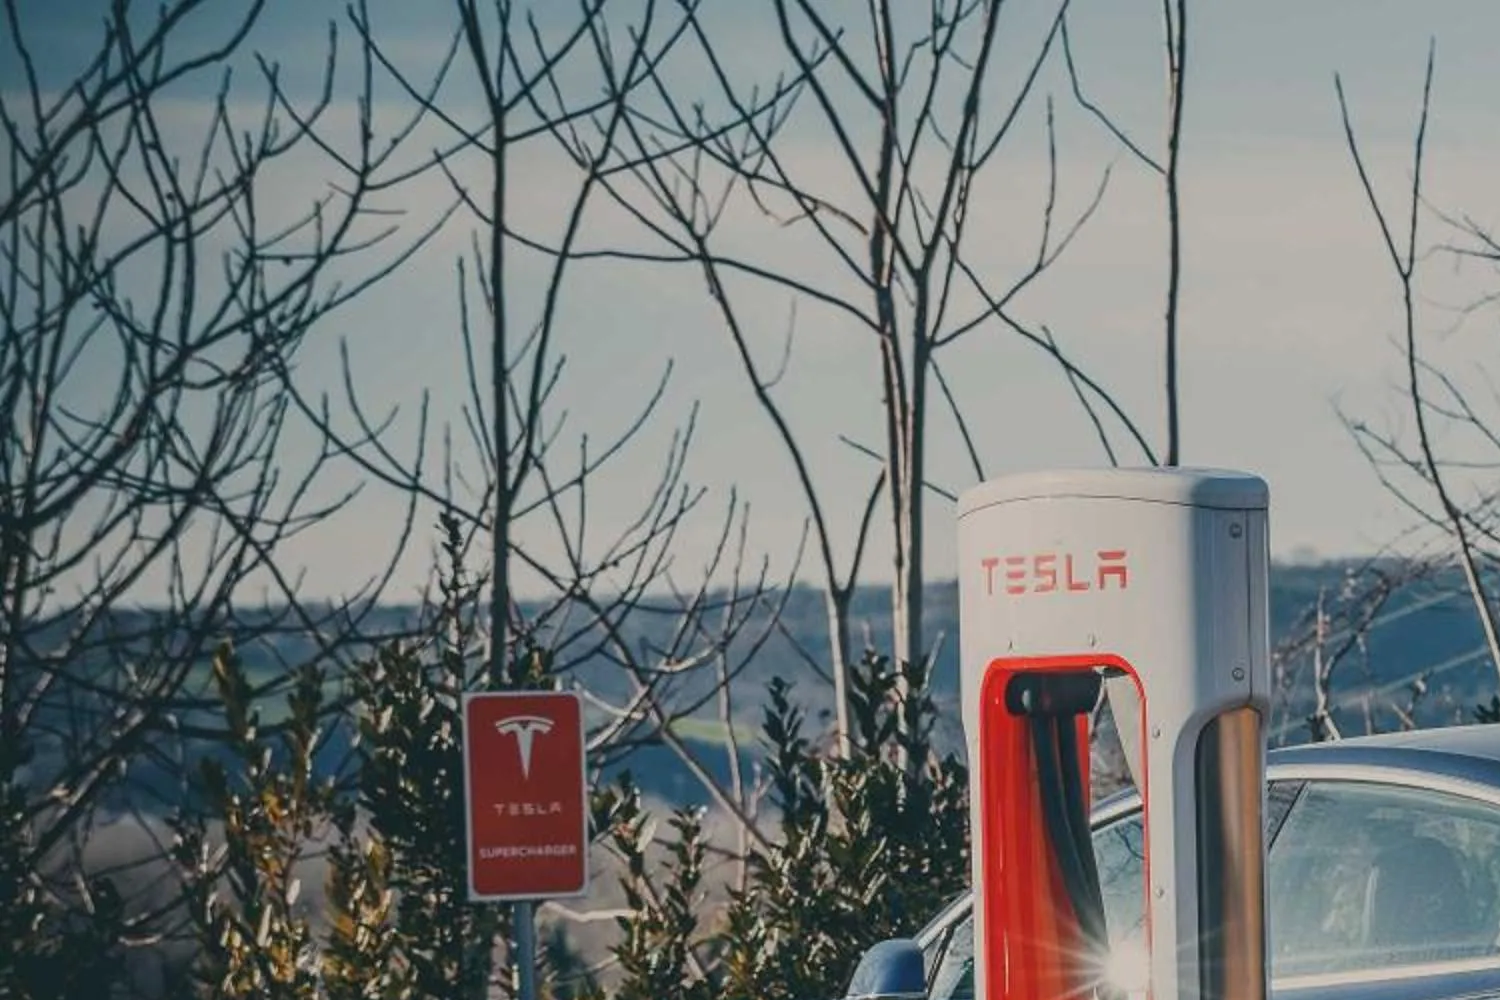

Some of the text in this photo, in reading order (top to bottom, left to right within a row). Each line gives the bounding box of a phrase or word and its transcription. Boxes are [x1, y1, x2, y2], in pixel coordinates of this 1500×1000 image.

[981, 550, 1128, 595] TESLA
[493, 802, 562, 816] TESLA
[479, 844, 577, 859] SUPERCHARGER
